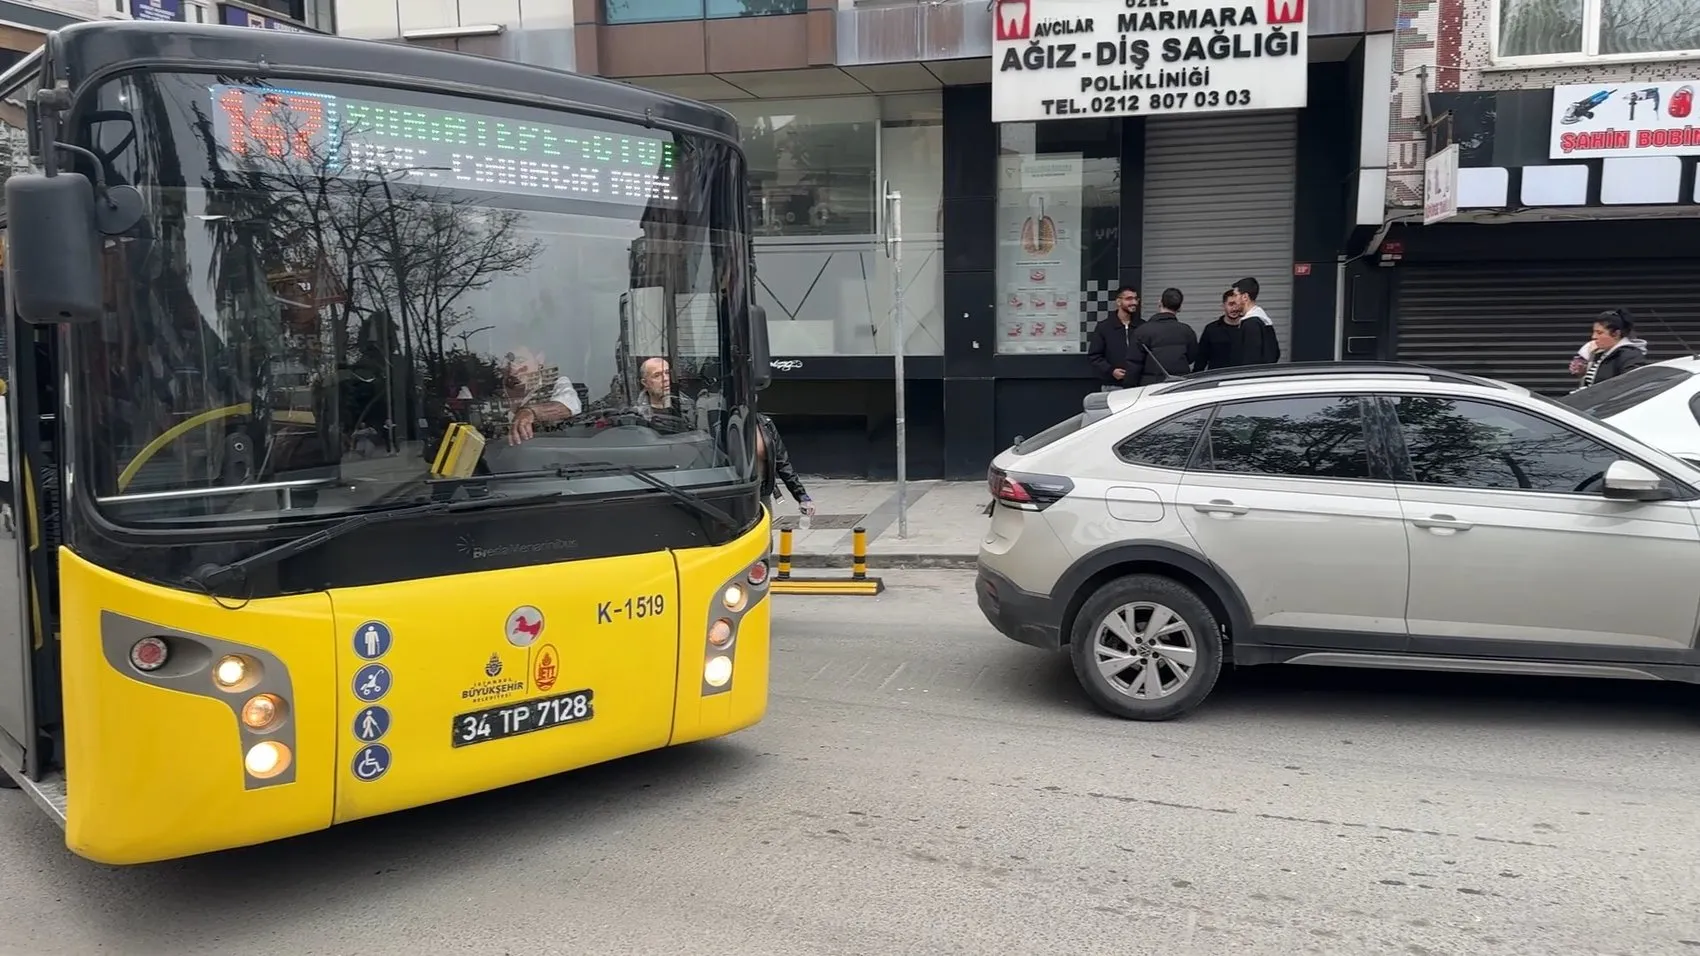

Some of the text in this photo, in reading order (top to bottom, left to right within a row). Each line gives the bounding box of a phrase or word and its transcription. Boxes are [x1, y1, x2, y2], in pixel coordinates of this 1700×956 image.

[1034, 6, 1258, 37] AVCILAR MARMARA
[1161, 26, 1299, 62] SAĞLIĞI
[1081, 66, 1210, 92] POLİKLİNİĞİ
[1149, 92, 1188, 109] 807
[1194, 91, 1220, 107] 03
[1225, 89, 1251, 106] 03
[1560, 127, 1630, 154] ŞAHİN
[597, 594, 665, 626] K-1519
[461, 680, 525, 699] BÜYÜKŞEHİR
[462, 694, 589, 742] 34 TP 7128
